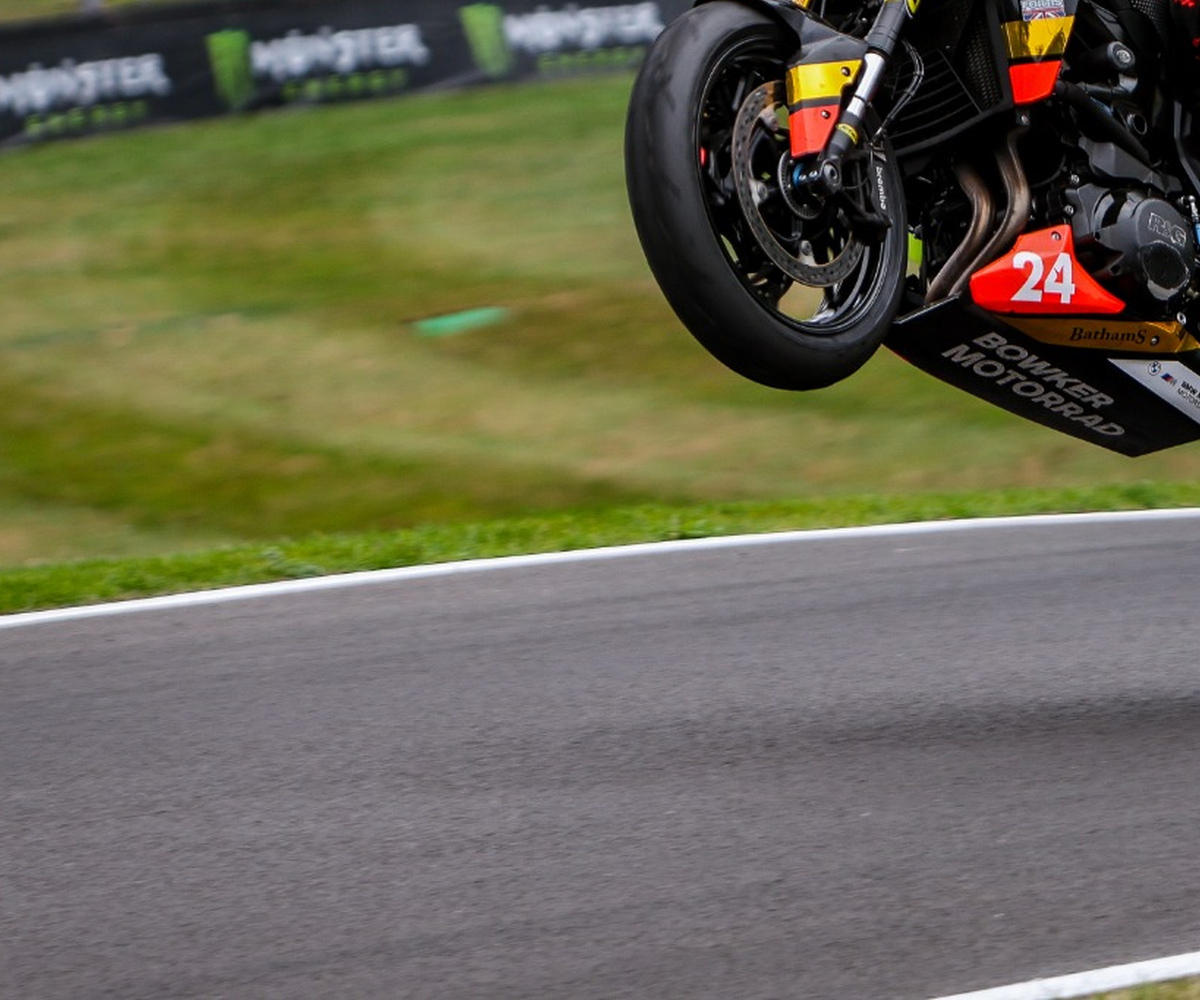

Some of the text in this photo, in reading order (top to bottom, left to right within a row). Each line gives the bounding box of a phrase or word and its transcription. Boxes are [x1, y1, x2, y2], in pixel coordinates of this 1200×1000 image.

[875, 165, 887, 210] brembo
[1011, 251, 1076, 304] 24
[941, 343, 1126, 437] MOTORRAD
[972, 331, 1114, 409] BOWKER
